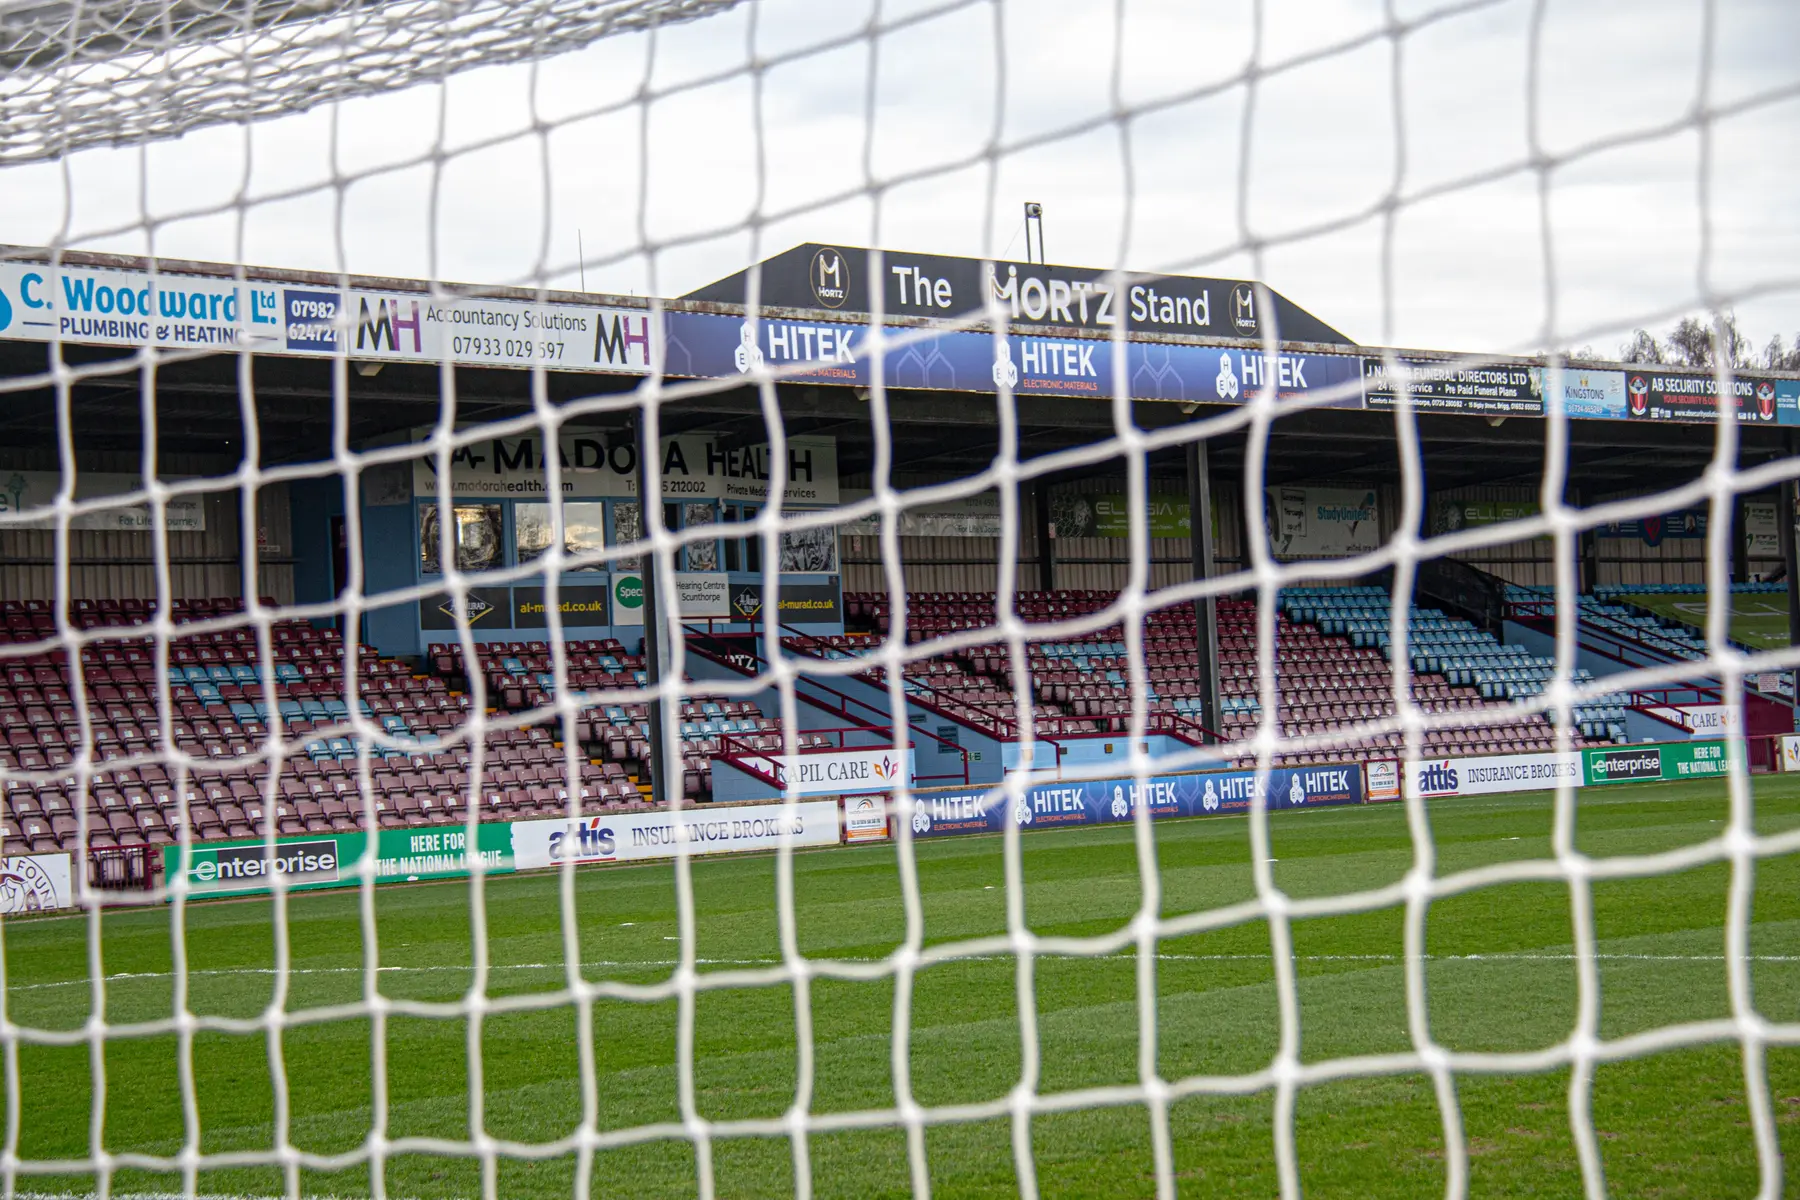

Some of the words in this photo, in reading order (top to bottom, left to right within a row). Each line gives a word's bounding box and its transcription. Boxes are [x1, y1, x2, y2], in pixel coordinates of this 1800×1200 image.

[20, 273, 53, 310] C.
[62, 276, 241, 322] Woodward
[892, 266, 952, 308] The
[1131, 285, 1211, 326] Stand
[291, 300, 336, 319] 07982
[426, 305, 519, 331] Accountancy
[523, 310, 587, 332] Solutions
[61, 317, 149, 339] PLUMBING
[156, 323, 169, 339] &
[356, 296, 422, 352] MH
[453, 336, 501, 355] 07933
[505, 339, 533, 358] 029
[538, 341, 564, 360] 597
[593, 313, 650, 366] MH
[768, 324, 856, 364] HITEK
[1021, 341, 1098, 377] HITEK
[817, 367, 857, 379] MATERIALS
[1241, 354, 1308, 388] HITEK
[1414, 367, 1456, 382] FUNERAL
[1458, 370, 1508, 385] DIRECTORS
[1509, 372, 1527, 385] LTD
[1023, 378, 1063, 389] ELECTRONIC
[1063, 381, 1098, 391] MATERIALS
[1406, 382, 1433, 393] Service
[1444, 384, 1456, 394] Pre
[1457, 384, 1473, 395] Paid
[1474, 385, 1498, 396] Funeral
[1499, 386, 1517, 397] Plans
[1652, 377, 1664, 392] AB
[1664, 378, 1705, 394] SECURITY
[705, 442, 813, 482] HEALH
[670, 481, 706, 494] 212002
[727, 483, 748, 496] Private
[749, 485, 768, 497] Medic
[783, 488, 816, 499] ervices
[676, 581, 702, 592] Hearing
[703, 580, 726, 590] Centre
[519, 601, 602, 614] al-mad.co.uk
[682, 592, 721, 603] Scunthorpe
[1692, 712, 1718, 729] CARE
[1693, 747, 1709, 759] HERE
[1709, 746, 1721, 758] FOR
[777, 763, 824, 784] KAPIL
[827, 760, 869, 782] CARE
[1468, 764, 1529, 783] INSURANCE
[1531, 762, 1577, 780] BROKERS
[1594, 755, 1660, 775] enterprise
[1677, 762, 1689, 775] THE
[1689, 760, 1717, 774] NATIONAL
[1220, 776, 1266, 800] HITEK
[1305, 770, 1349, 793] HITEK
[1033, 788, 1085, 813] HITEK
[1129, 782, 1178, 806] HITEK
[932, 794, 987, 821] HITEK
[410, 834, 441, 853] HERE
[443, 832, 466, 851] FOR
[194, 850, 336, 881] enterprise
[375, 857, 397, 876] THE
[399, 853, 457, 875] NATIONAL
[460, 850, 503, 870] LGUE
